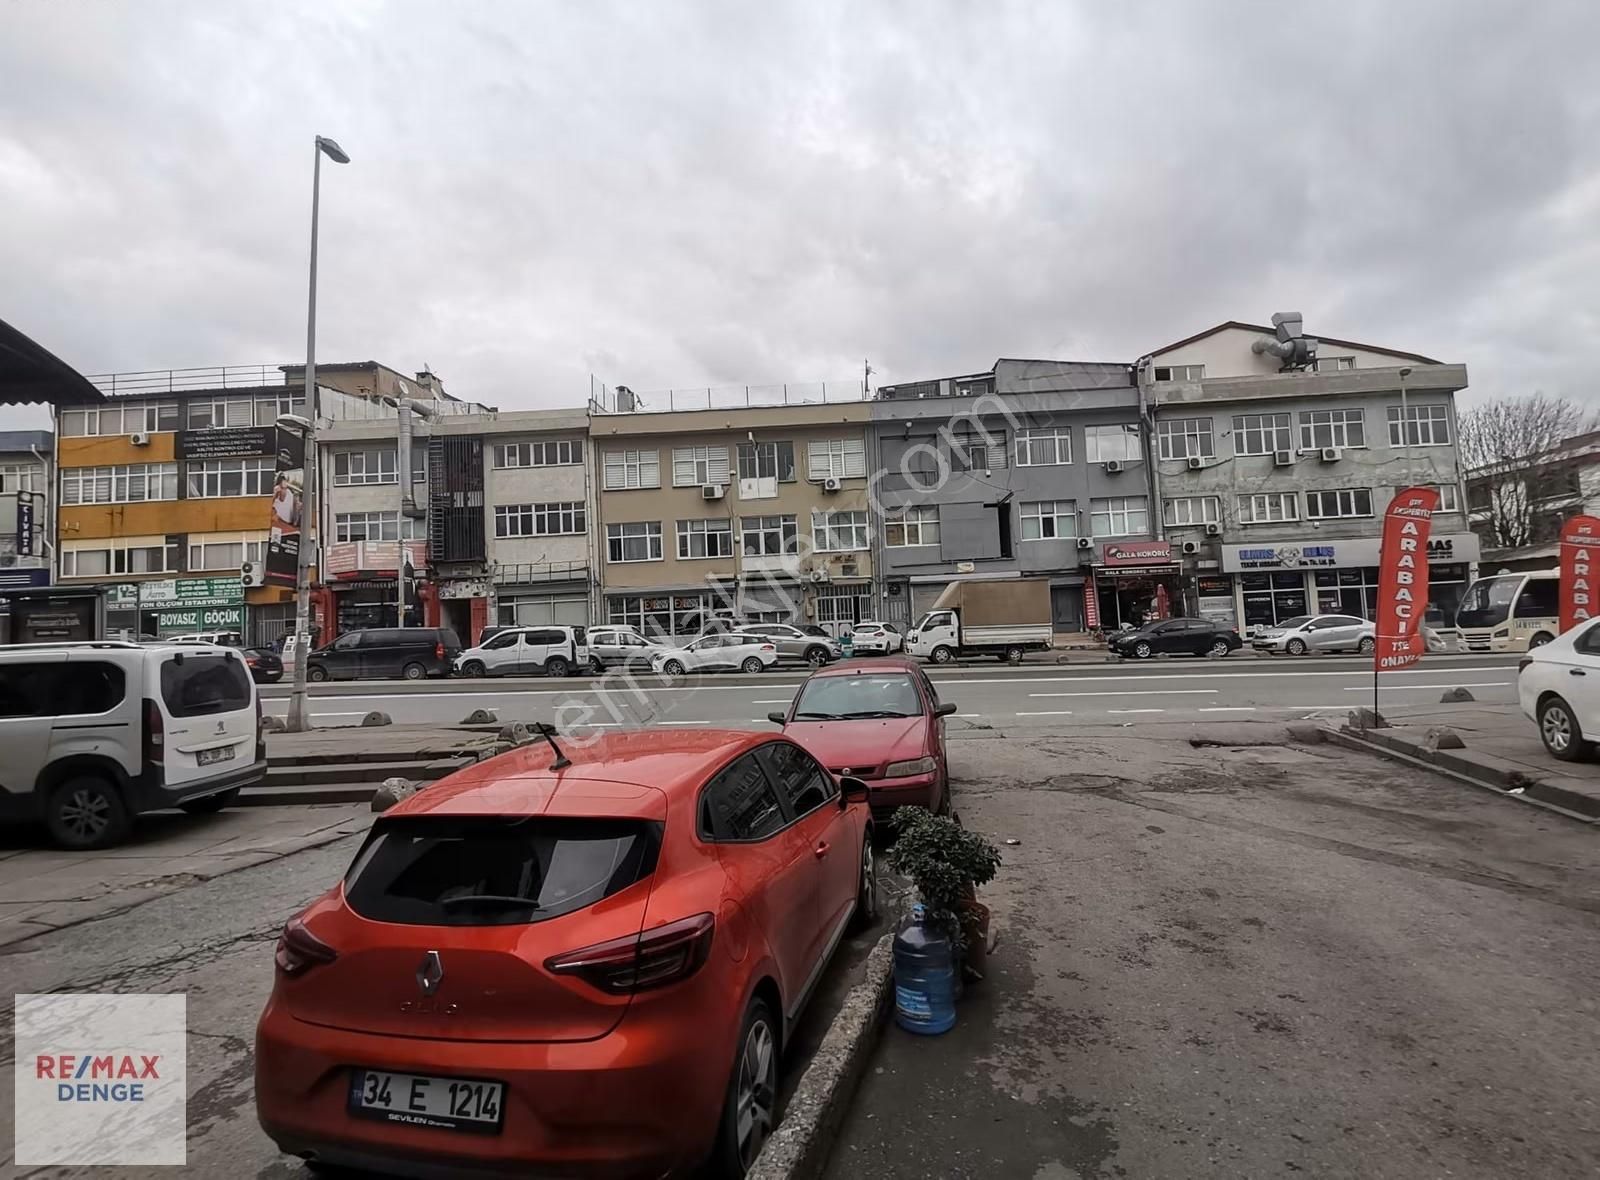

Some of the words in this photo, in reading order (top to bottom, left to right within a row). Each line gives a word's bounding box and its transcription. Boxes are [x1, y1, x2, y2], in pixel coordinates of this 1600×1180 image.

[1395, 521, 1419, 634] ARABACI
[160, 612, 197, 626] BOYASIZ
[204, 609, 240, 626] GÖÇÜK
[364, 1073, 392, 1107] 34
[408, 1078, 430, 1111] E
[448, 1083, 497, 1119] 1214
[388, 1112, 427, 1125] SEVİLEN
